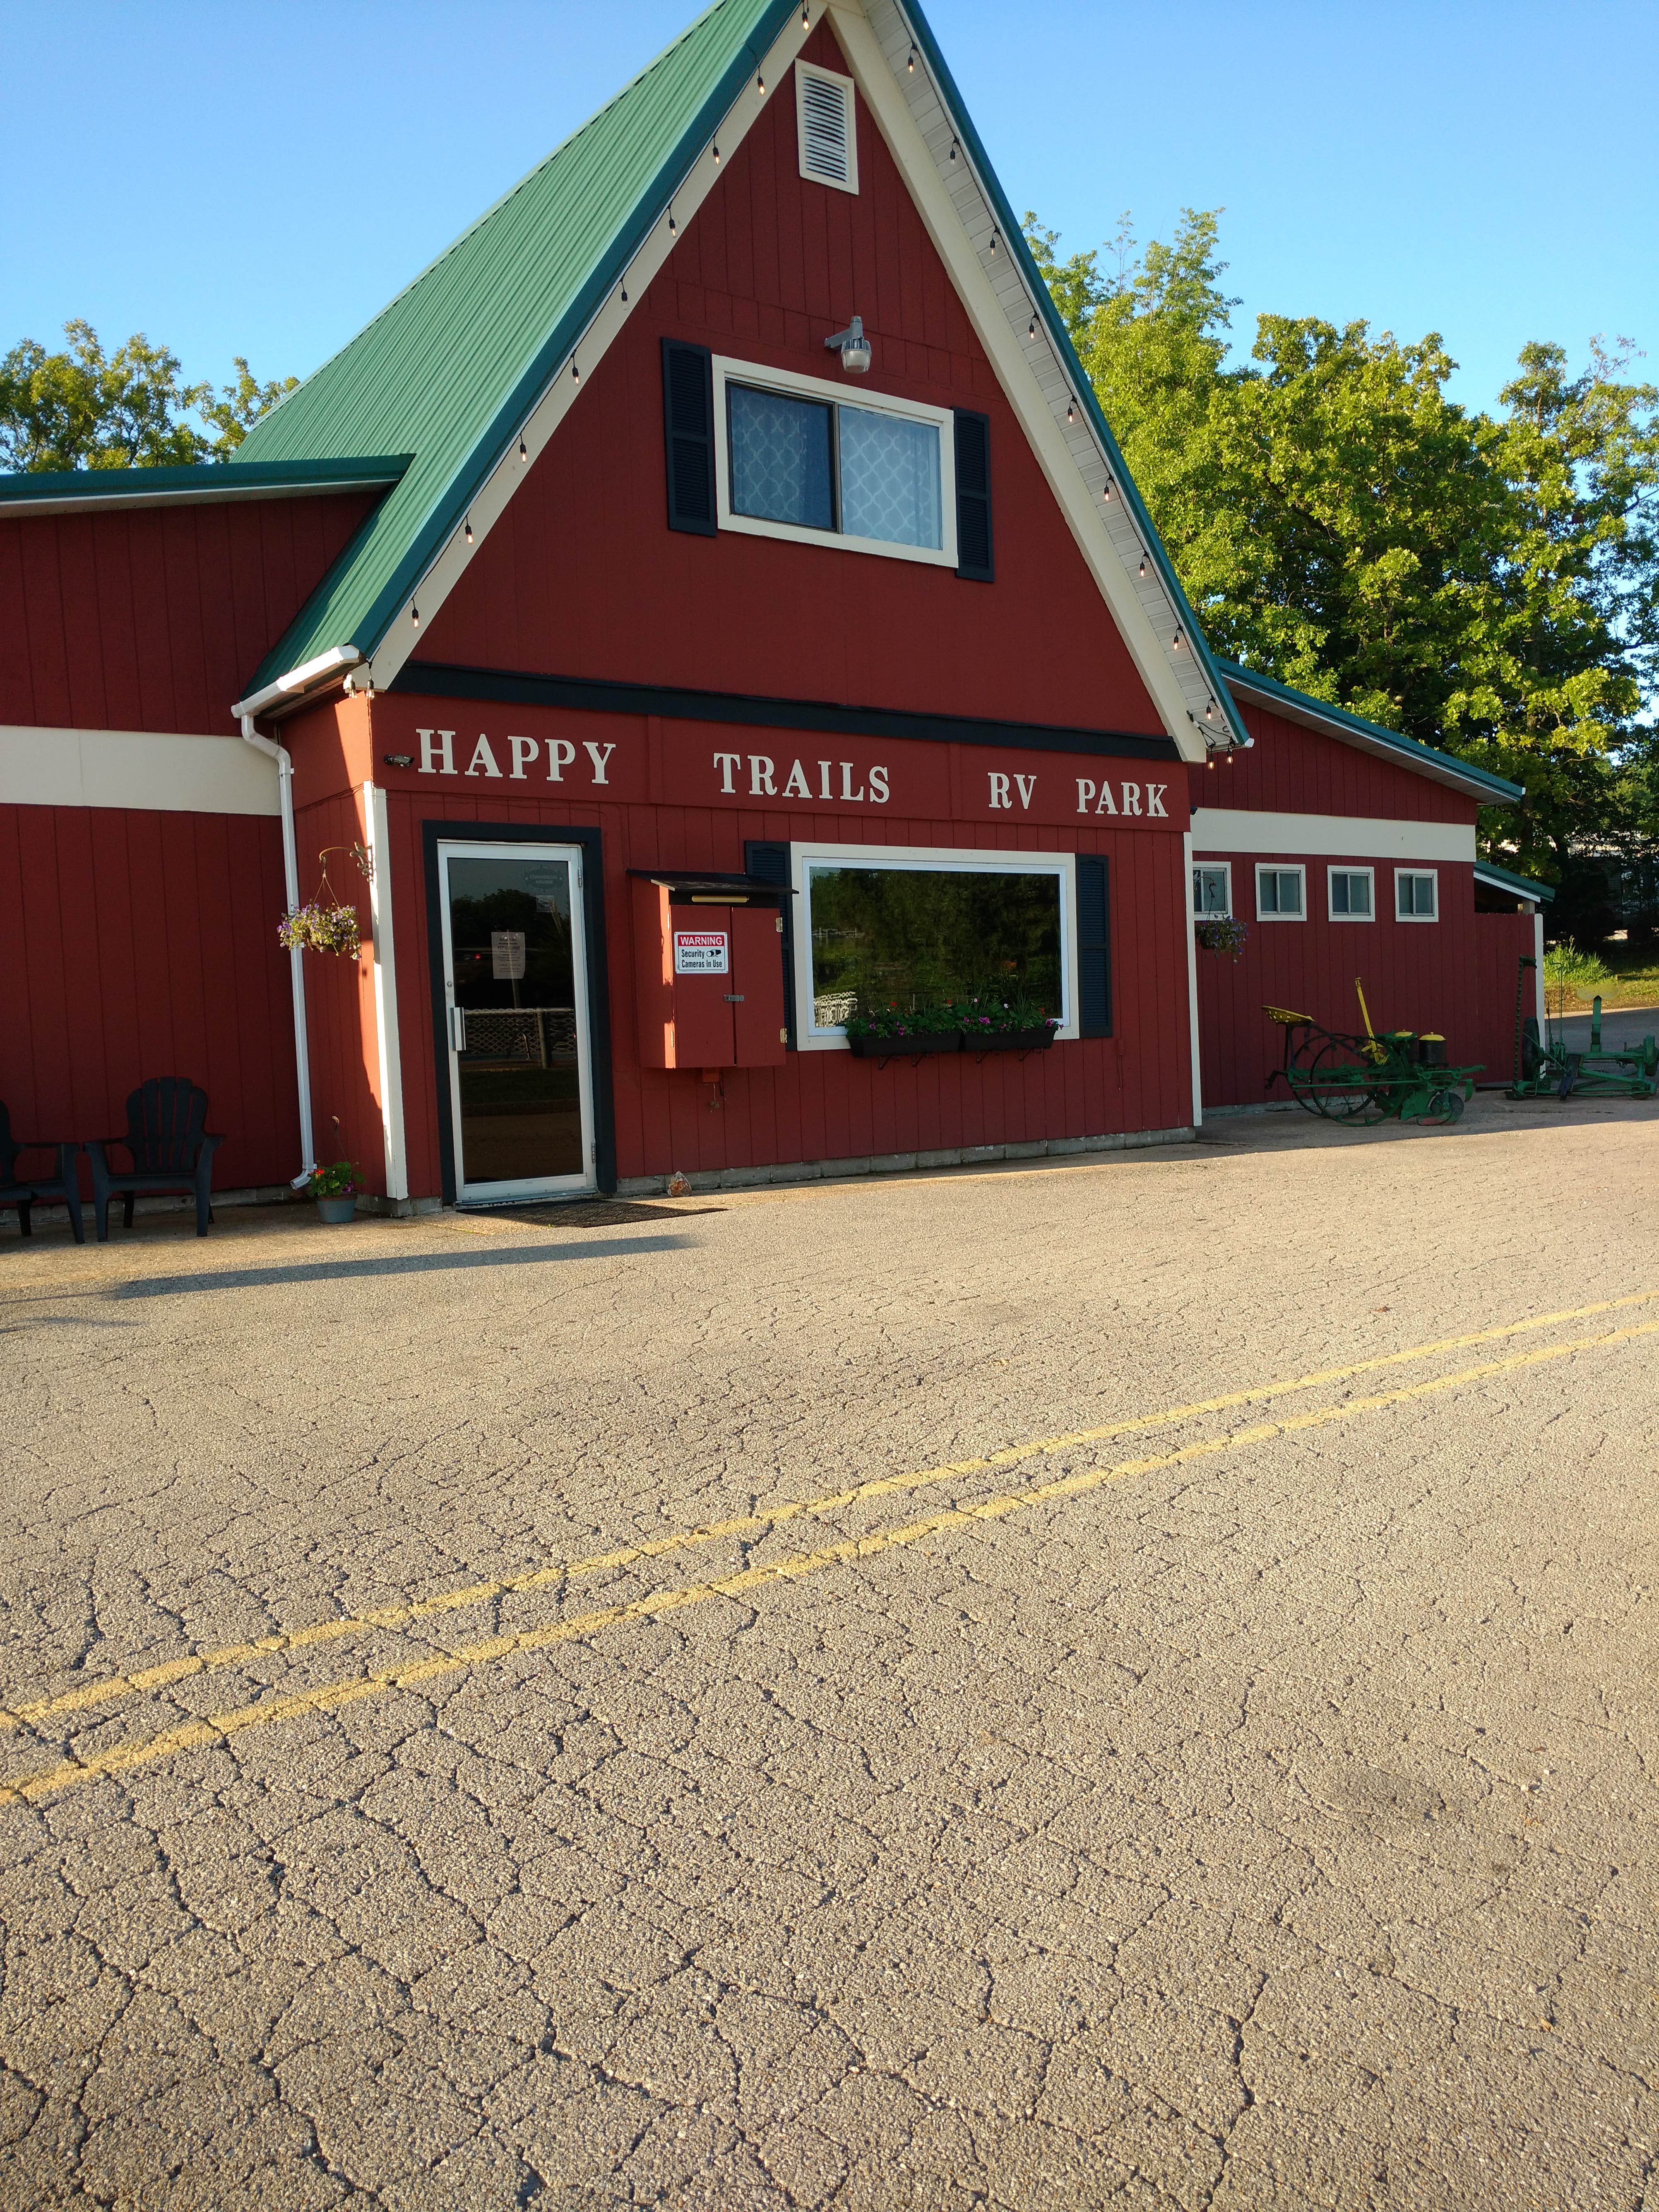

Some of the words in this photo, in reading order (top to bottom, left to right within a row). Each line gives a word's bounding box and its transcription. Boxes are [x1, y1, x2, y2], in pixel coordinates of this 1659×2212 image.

[416, 729, 616, 784] HAPPY
[713, 753, 890, 803] TRAILS
[988, 772, 1037, 810] RV
[1076, 778, 1169, 817] PARK
[680, 936, 722, 945] WARNING
[681, 949, 704, 959] Security
[682, 959, 704, 968] Cameras
[713, 959, 722, 967] Use
